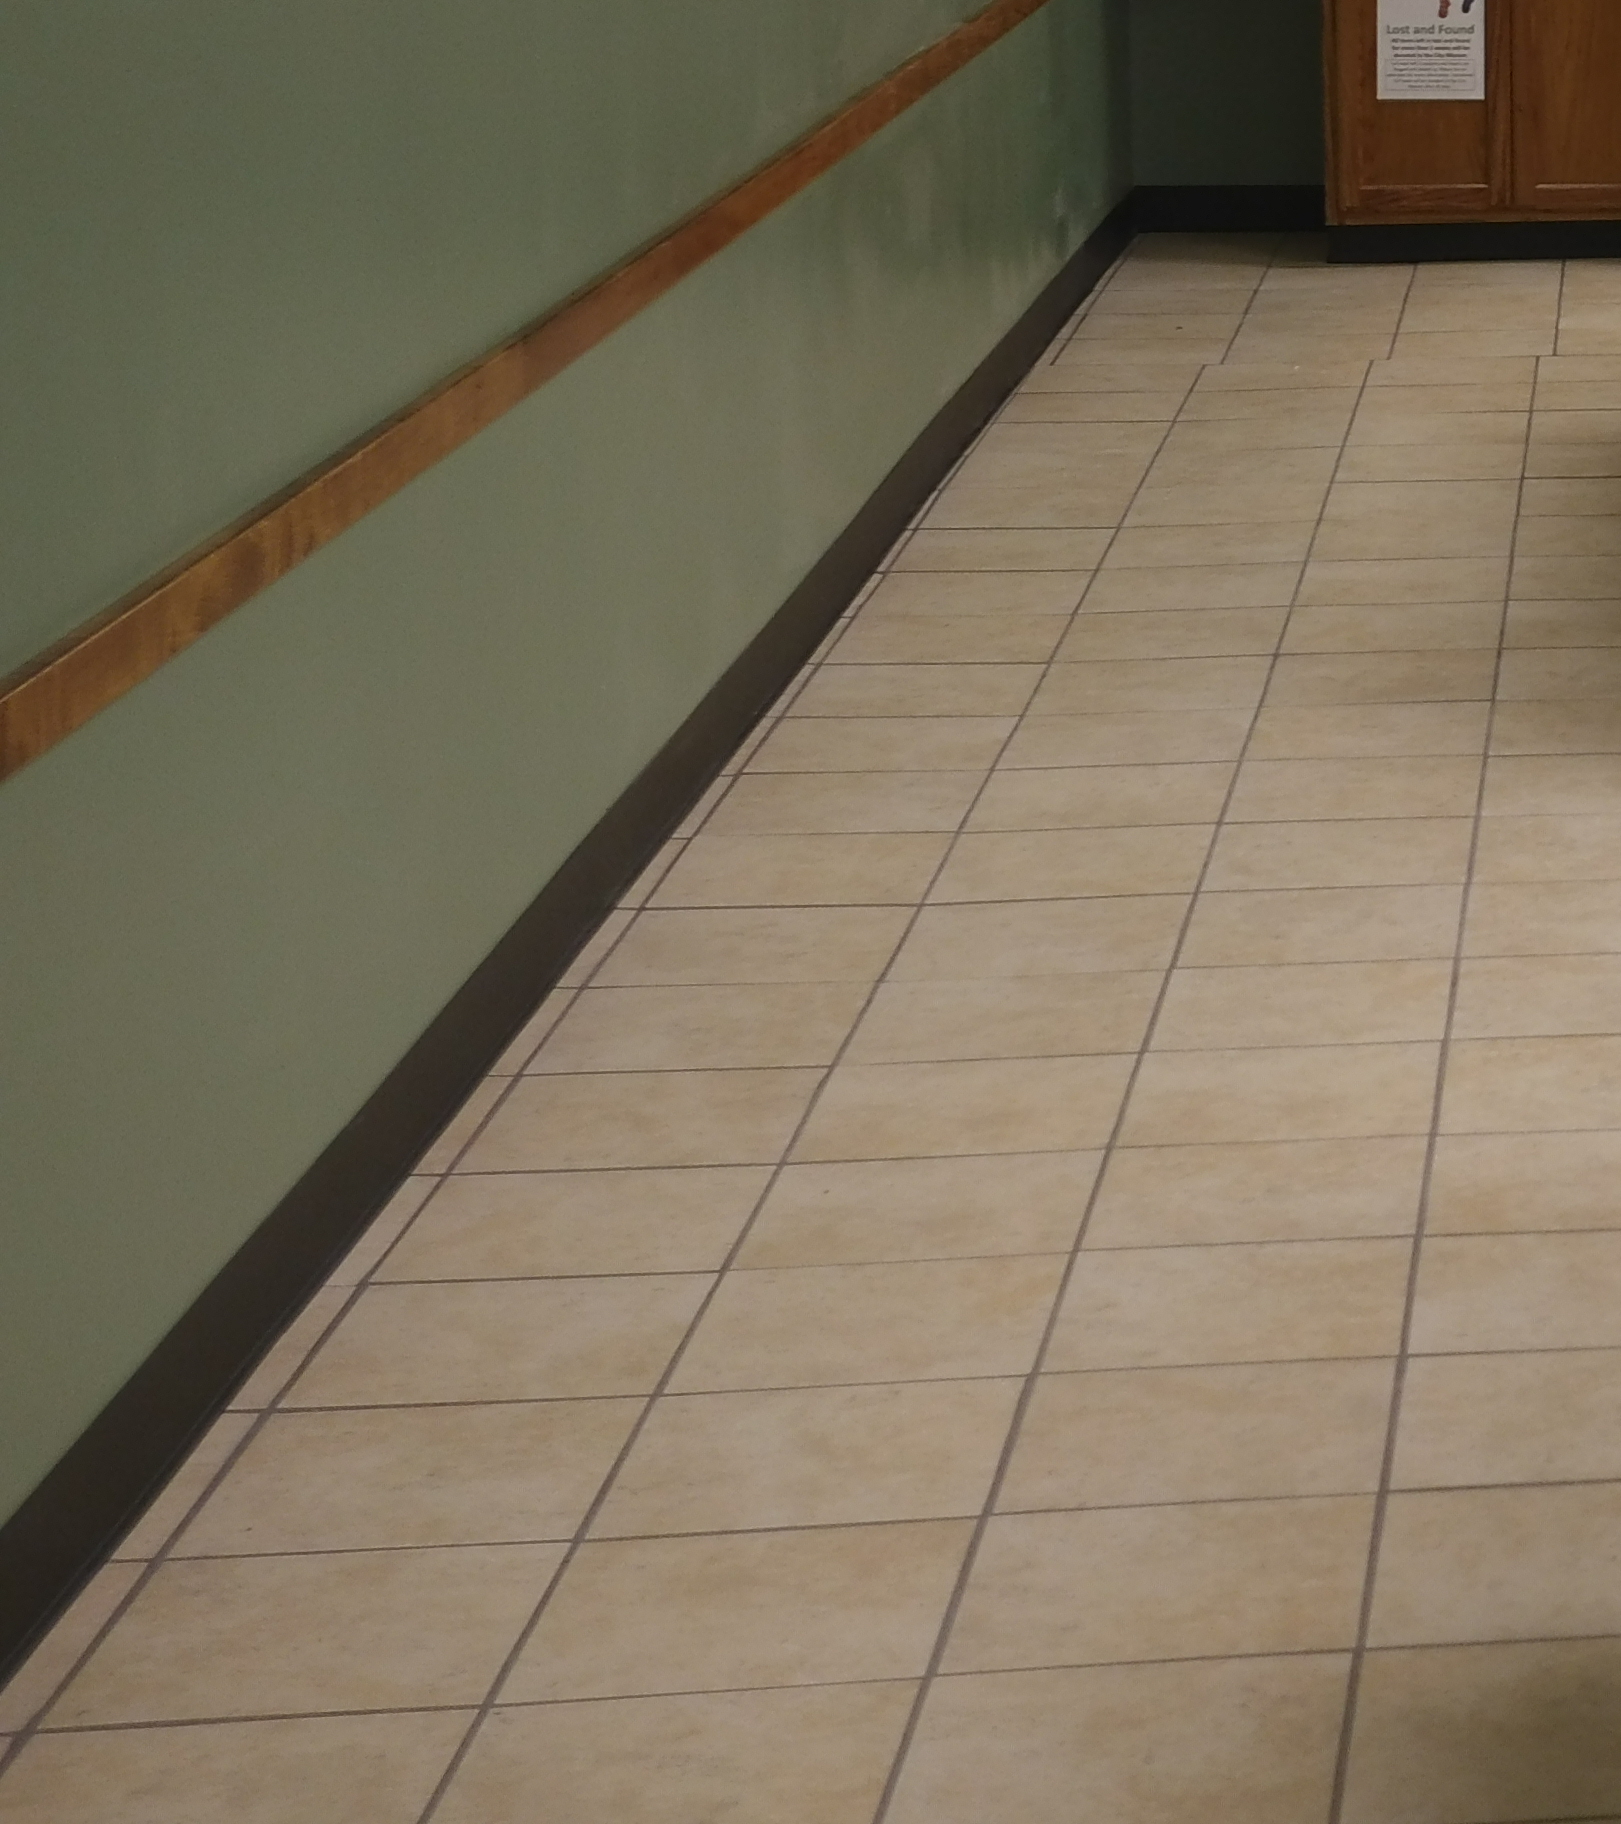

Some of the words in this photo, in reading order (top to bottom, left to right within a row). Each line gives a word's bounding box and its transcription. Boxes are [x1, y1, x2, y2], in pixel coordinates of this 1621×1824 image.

[1386, 25, 1411, 34] Lost
[1413, 25, 1435, 34] and
[1438, 24, 1475, 34] Found
